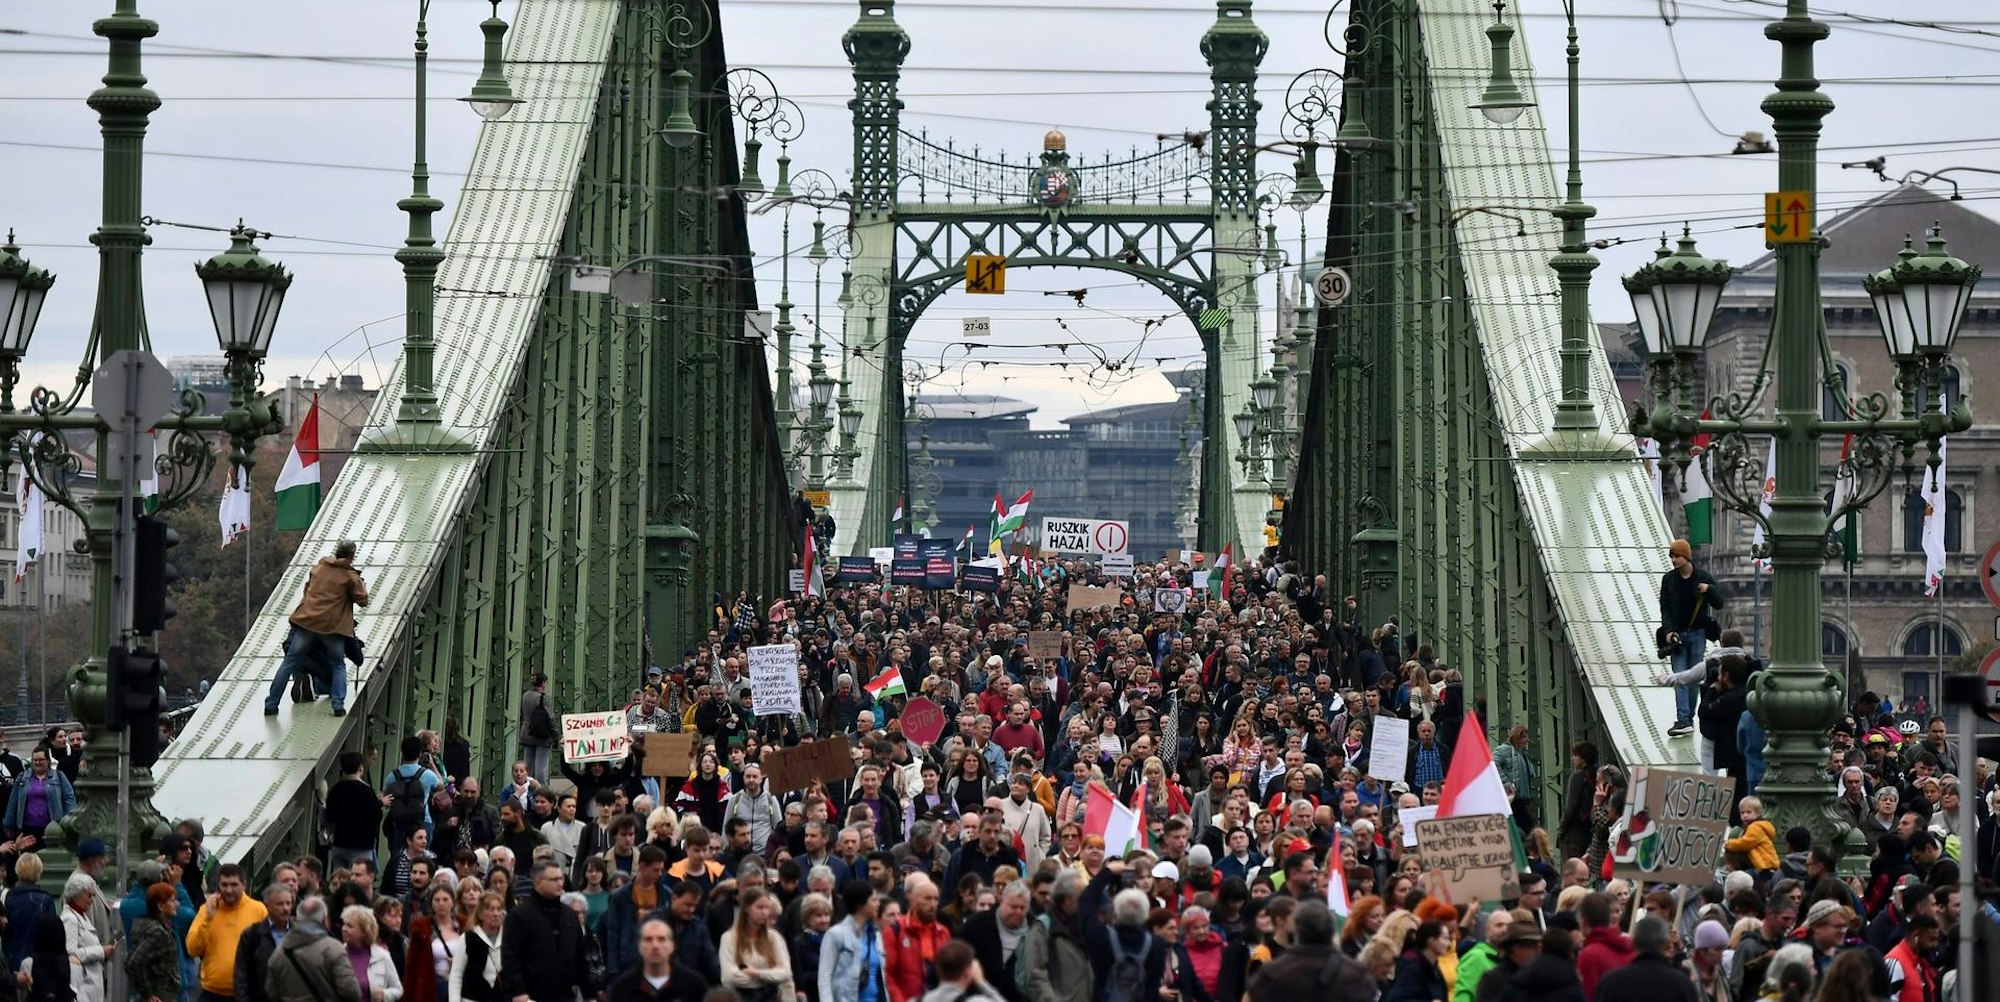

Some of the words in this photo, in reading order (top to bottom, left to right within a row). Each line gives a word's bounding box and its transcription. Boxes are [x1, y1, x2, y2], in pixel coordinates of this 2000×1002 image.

[1321, 277, 1342, 294] 30
[964, 322, 989, 331] 27-03
[1048, 521, 1089, 535] RUSZKIK
[1050, 535, 1089, 553] HAZA!
[907, 708, 939, 733] STOP
[1662, 775, 1694, 820] KIS
[1421, 823, 1442, 837] HA
[1444, 820, 1481, 837] ENNEK
[1480, 834, 1507, 846] VISSZA
[1678, 827, 1722, 873] FOCI
